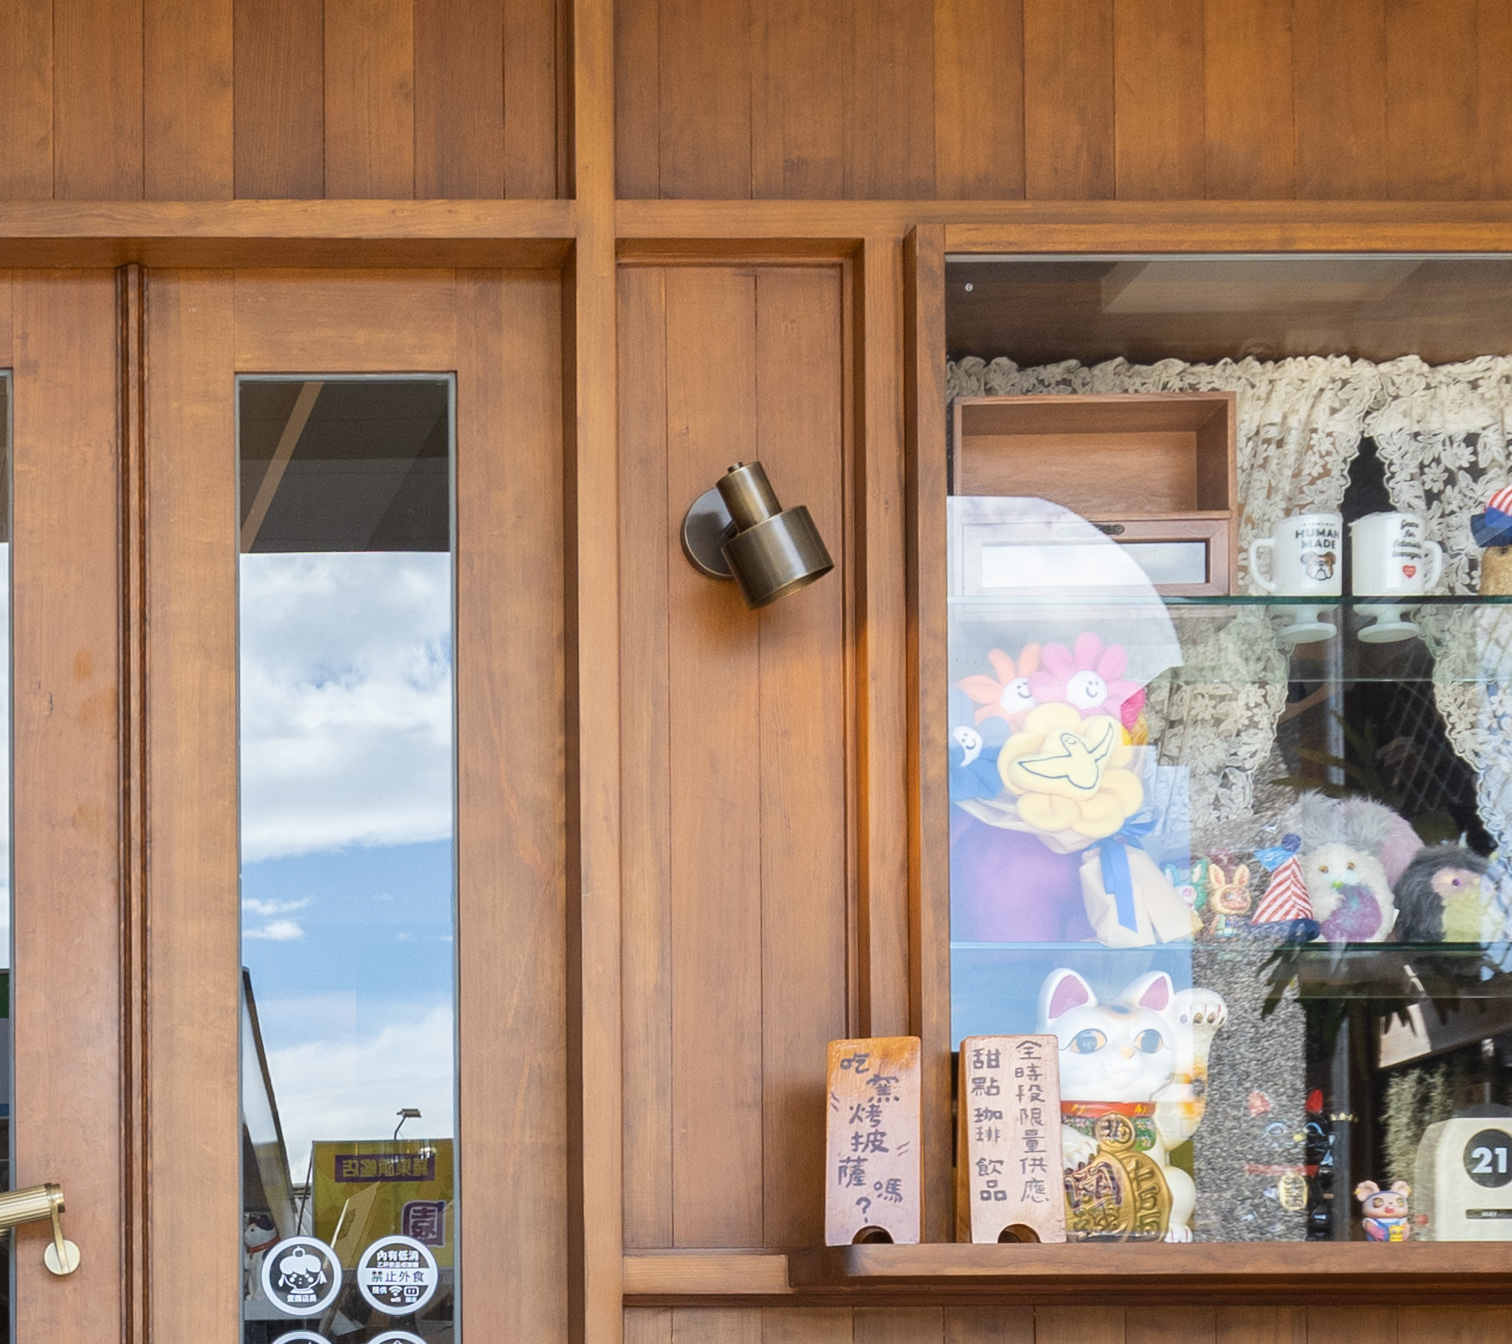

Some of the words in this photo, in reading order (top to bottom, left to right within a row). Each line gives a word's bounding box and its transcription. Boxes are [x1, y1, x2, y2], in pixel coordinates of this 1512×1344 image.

[1295, 528, 1340, 539] HUMAN
[1301, 539, 1337, 549] MADE
[971, 1048, 1001, 1097] 甜點
[973, 1107, 1004, 1143] 珈琲
[1014, 1040, 1050, 1204] 全時段限量供應
[1471, 1146, 1508, 1174] 21
[975, 1158, 1007, 1202] 飲品
[371, 1270, 425, 1283] 禁止外食
